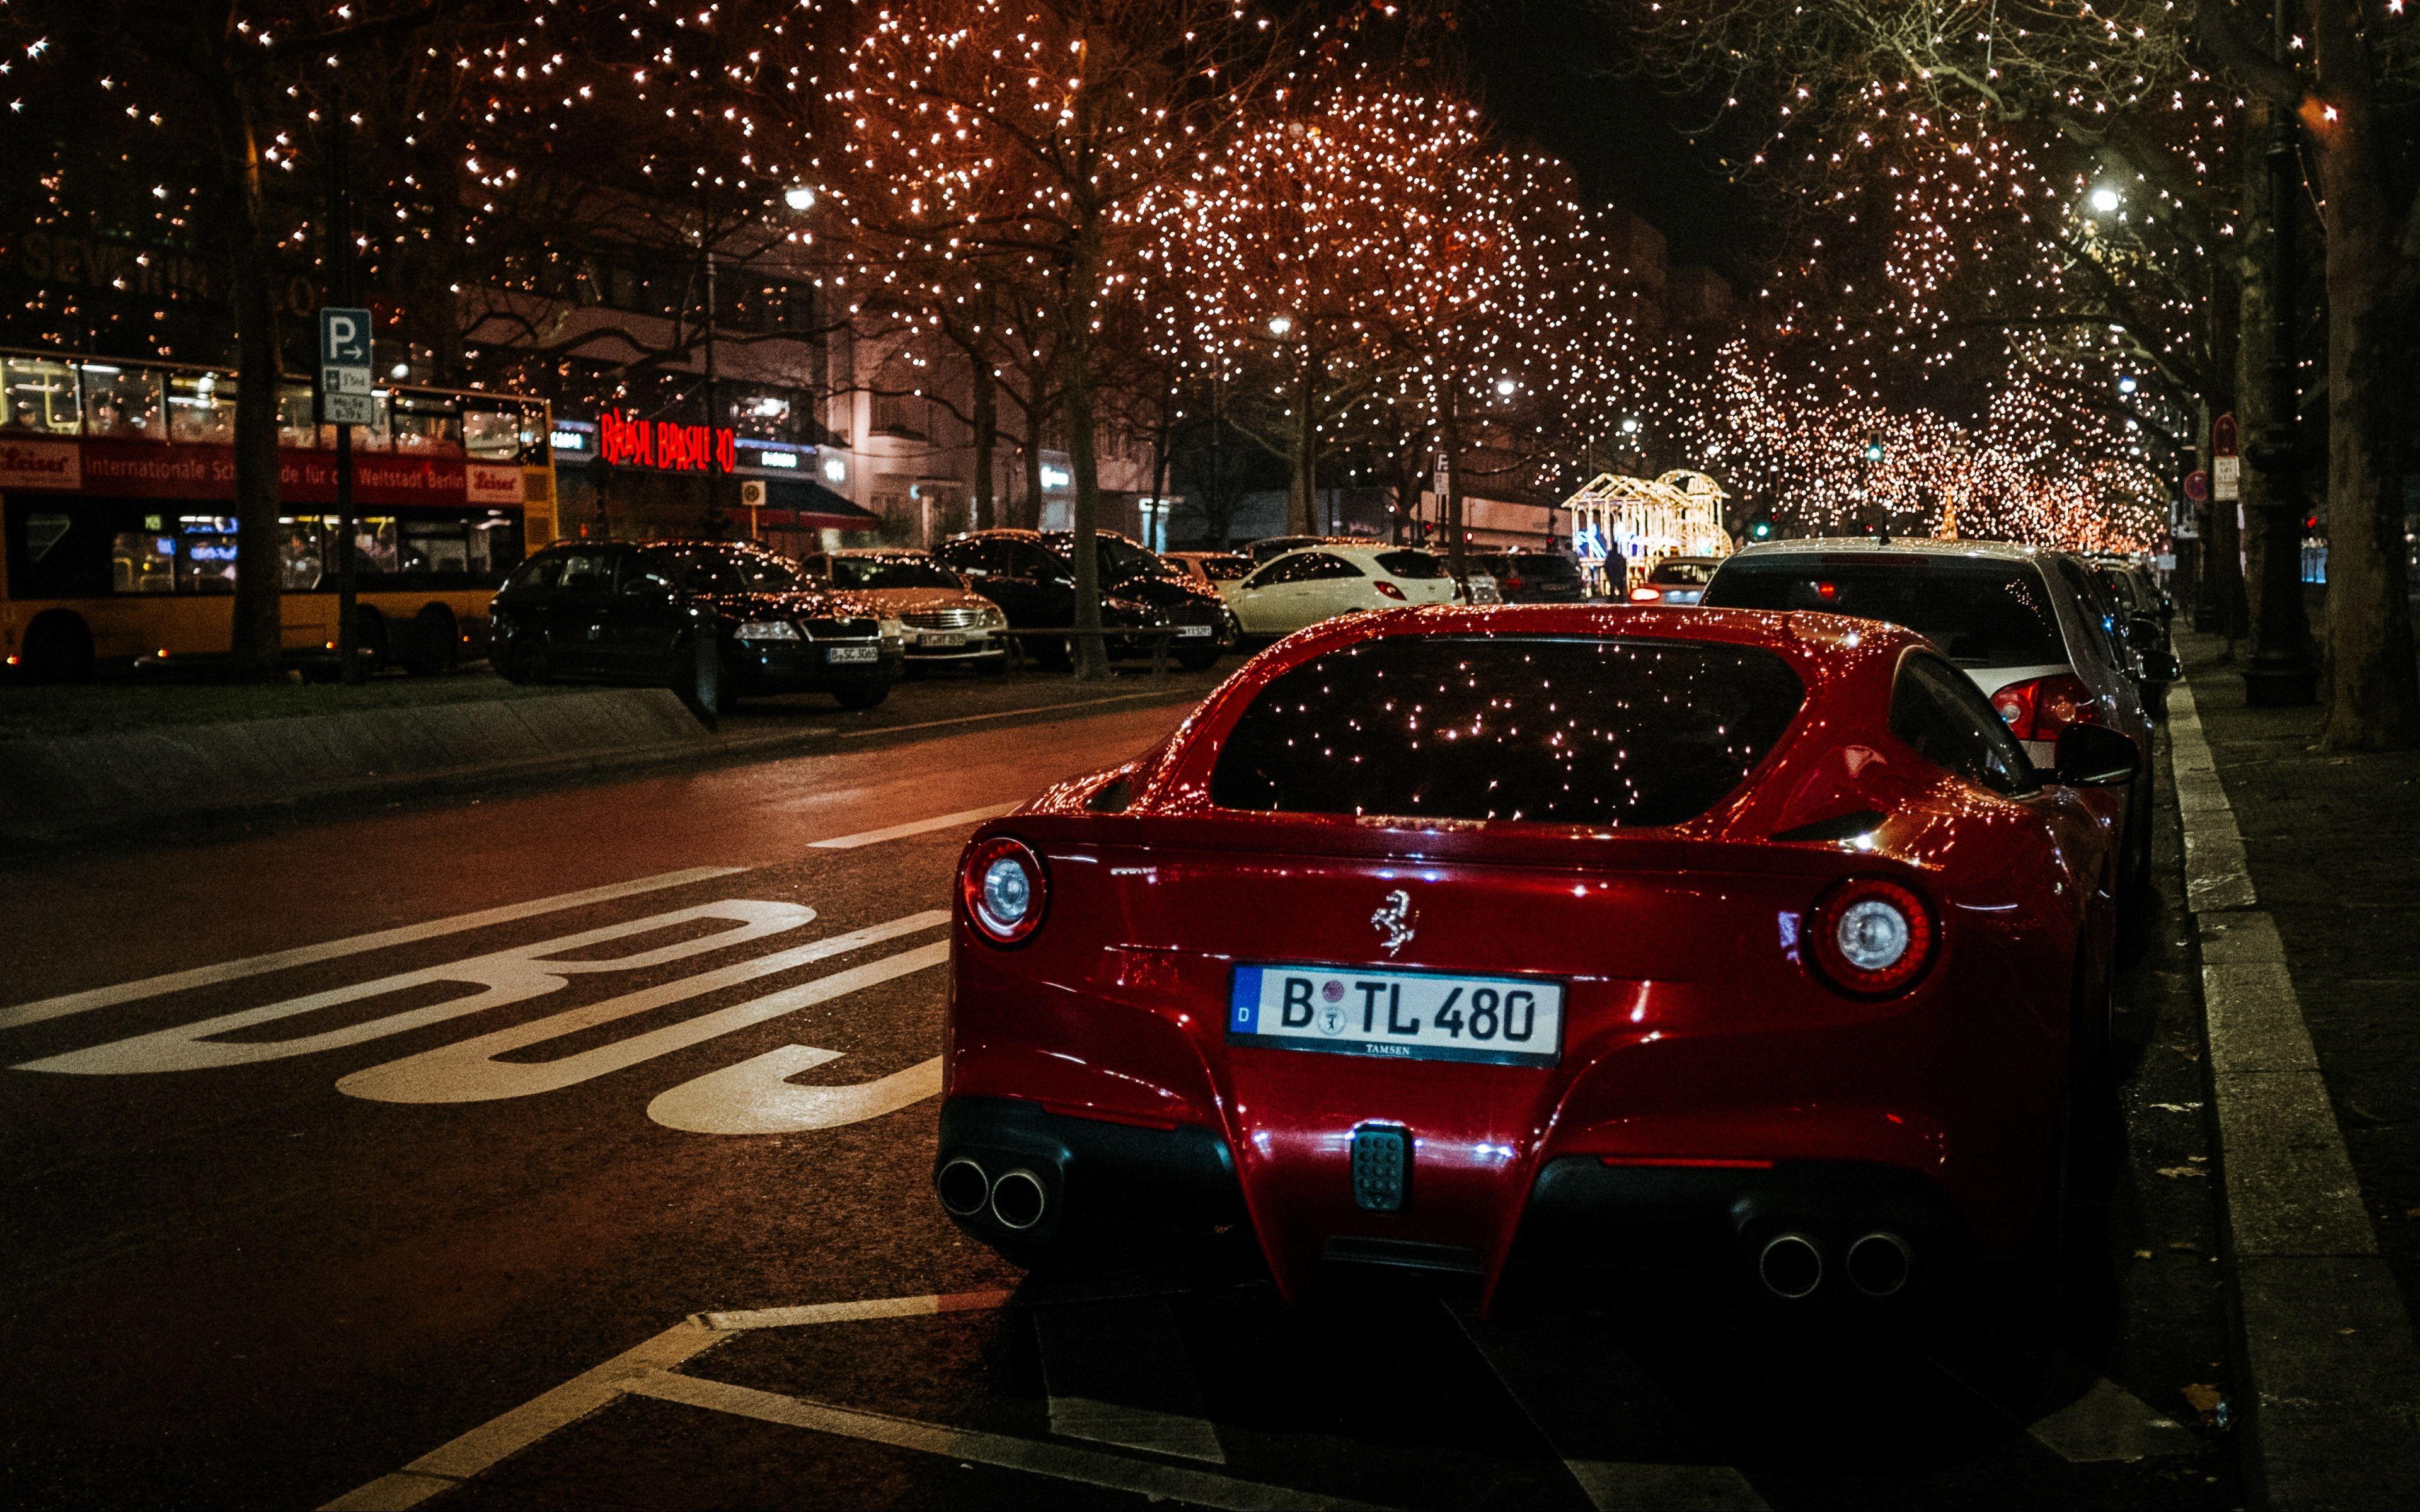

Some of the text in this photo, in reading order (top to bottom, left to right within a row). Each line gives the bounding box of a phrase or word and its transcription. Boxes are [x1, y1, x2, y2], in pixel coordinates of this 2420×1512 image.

[330, 316, 357, 360] P
[86, 457, 205, 480] Internationale
[304, 464, 326, 484] für
[359, 466, 423, 489] Weltstadt
[428, 469, 464, 490] Berlin
[1238, 976, 1536, 1042] D B TL 480
[1365, 1043, 1411, 1057] TAMSEN
